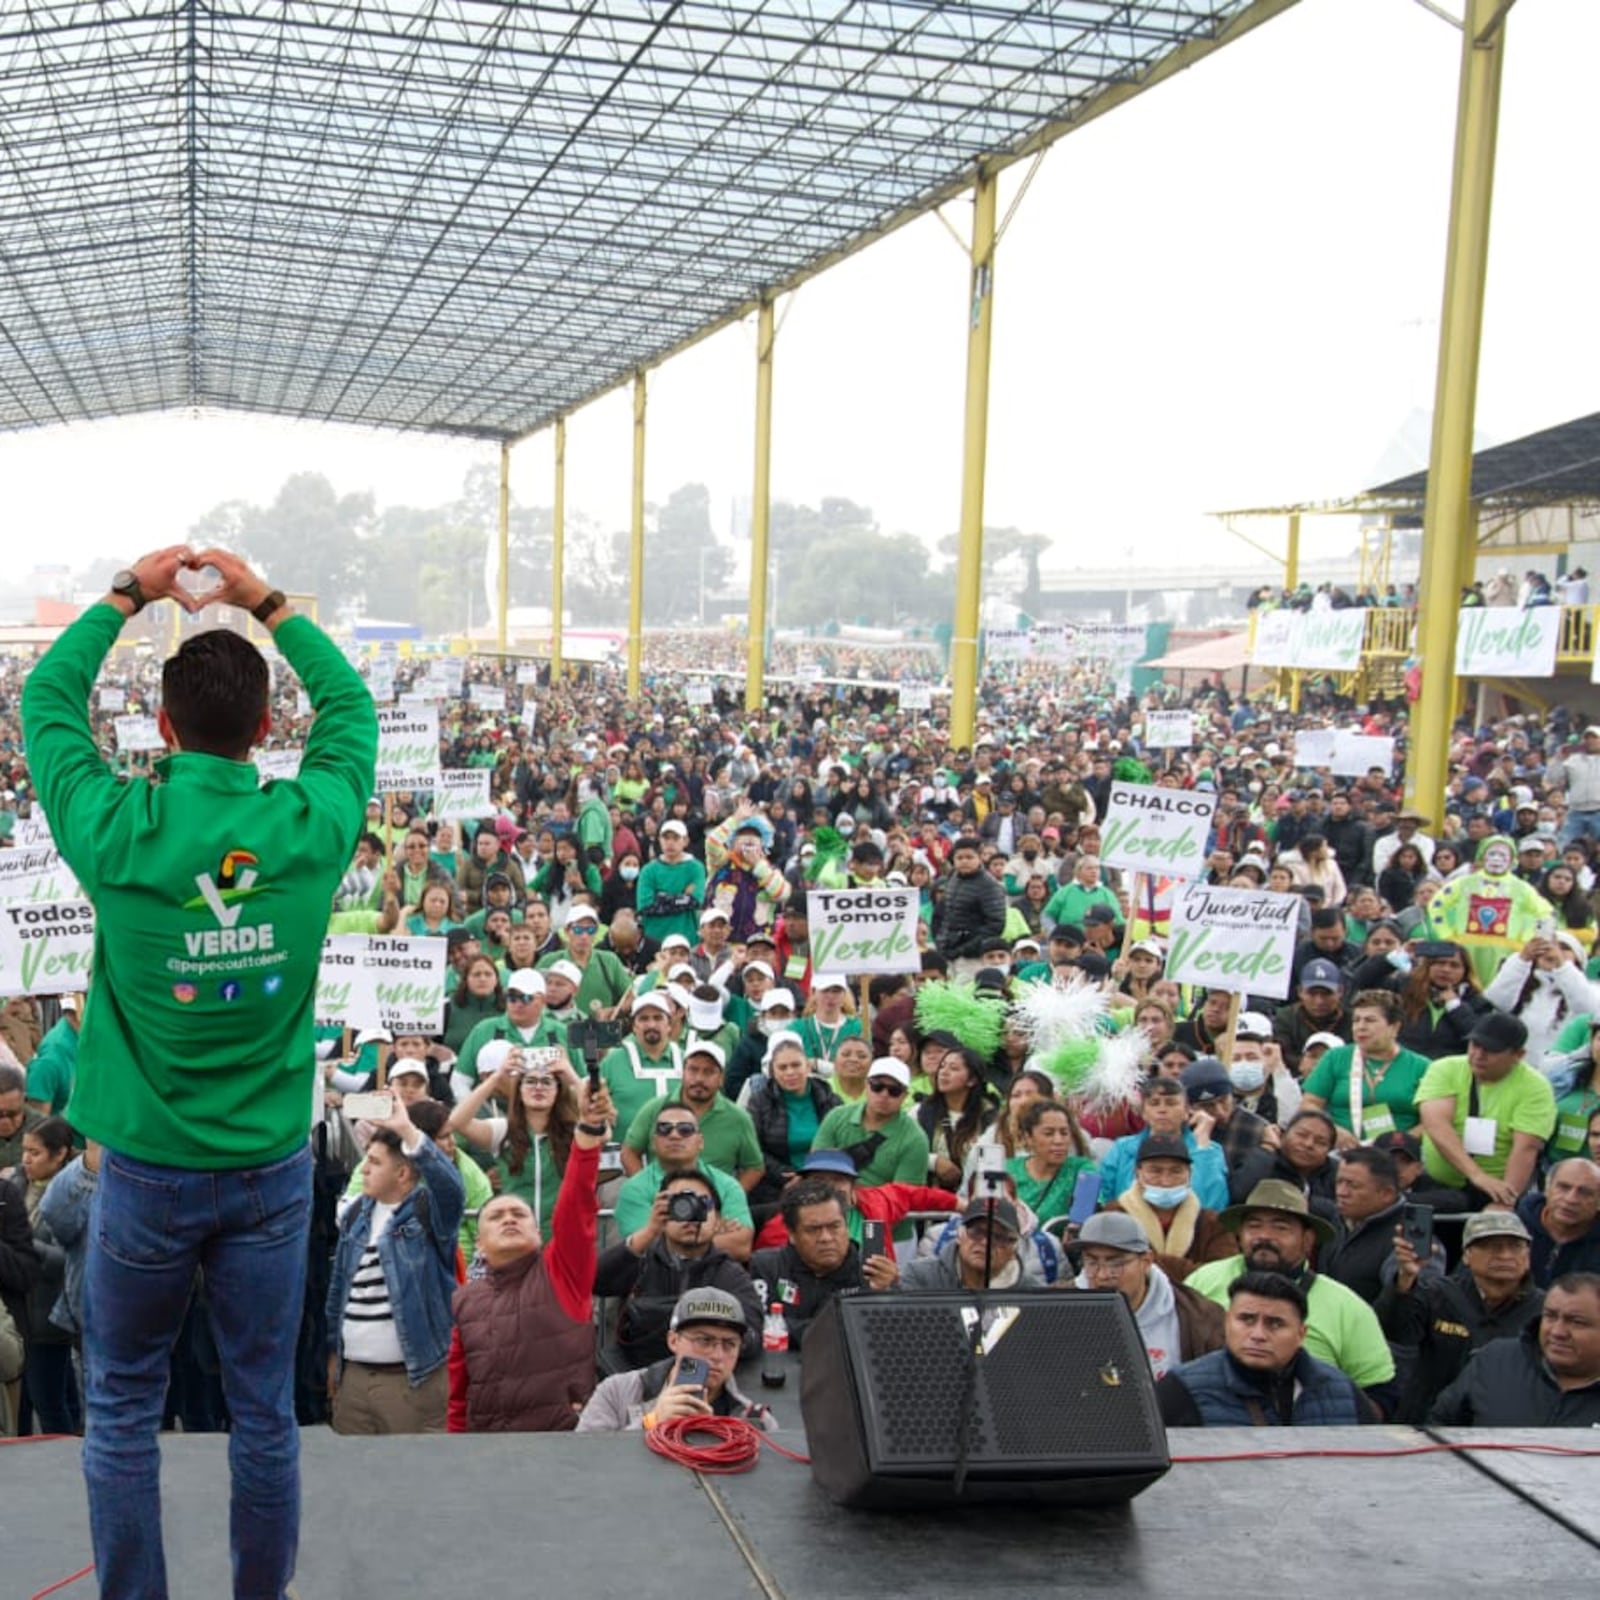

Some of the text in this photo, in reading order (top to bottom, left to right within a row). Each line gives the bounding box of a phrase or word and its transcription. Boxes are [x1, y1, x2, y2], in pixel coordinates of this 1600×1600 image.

[1462, 605, 1544, 671] Verde
[380, 723, 428, 734] uesta
[440, 771, 484, 781] Todos
[1112, 792, 1212, 817] CHALCO
[1101, 817, 1198, 863] Verde
[817, 893, 908, 911] Todos
[1186, 892, 1298, 923] Juventud
[6, 904, 93, 924] Todos
[827, 911, 905, 923] somos
[19, 923, 94, 939] somos
[184, 922, 274, 957] VERDE
[391, 939, 409, 952] la
[814, 922, 913, 974] Verde
[1166, 927, 1286, 981] Verde
